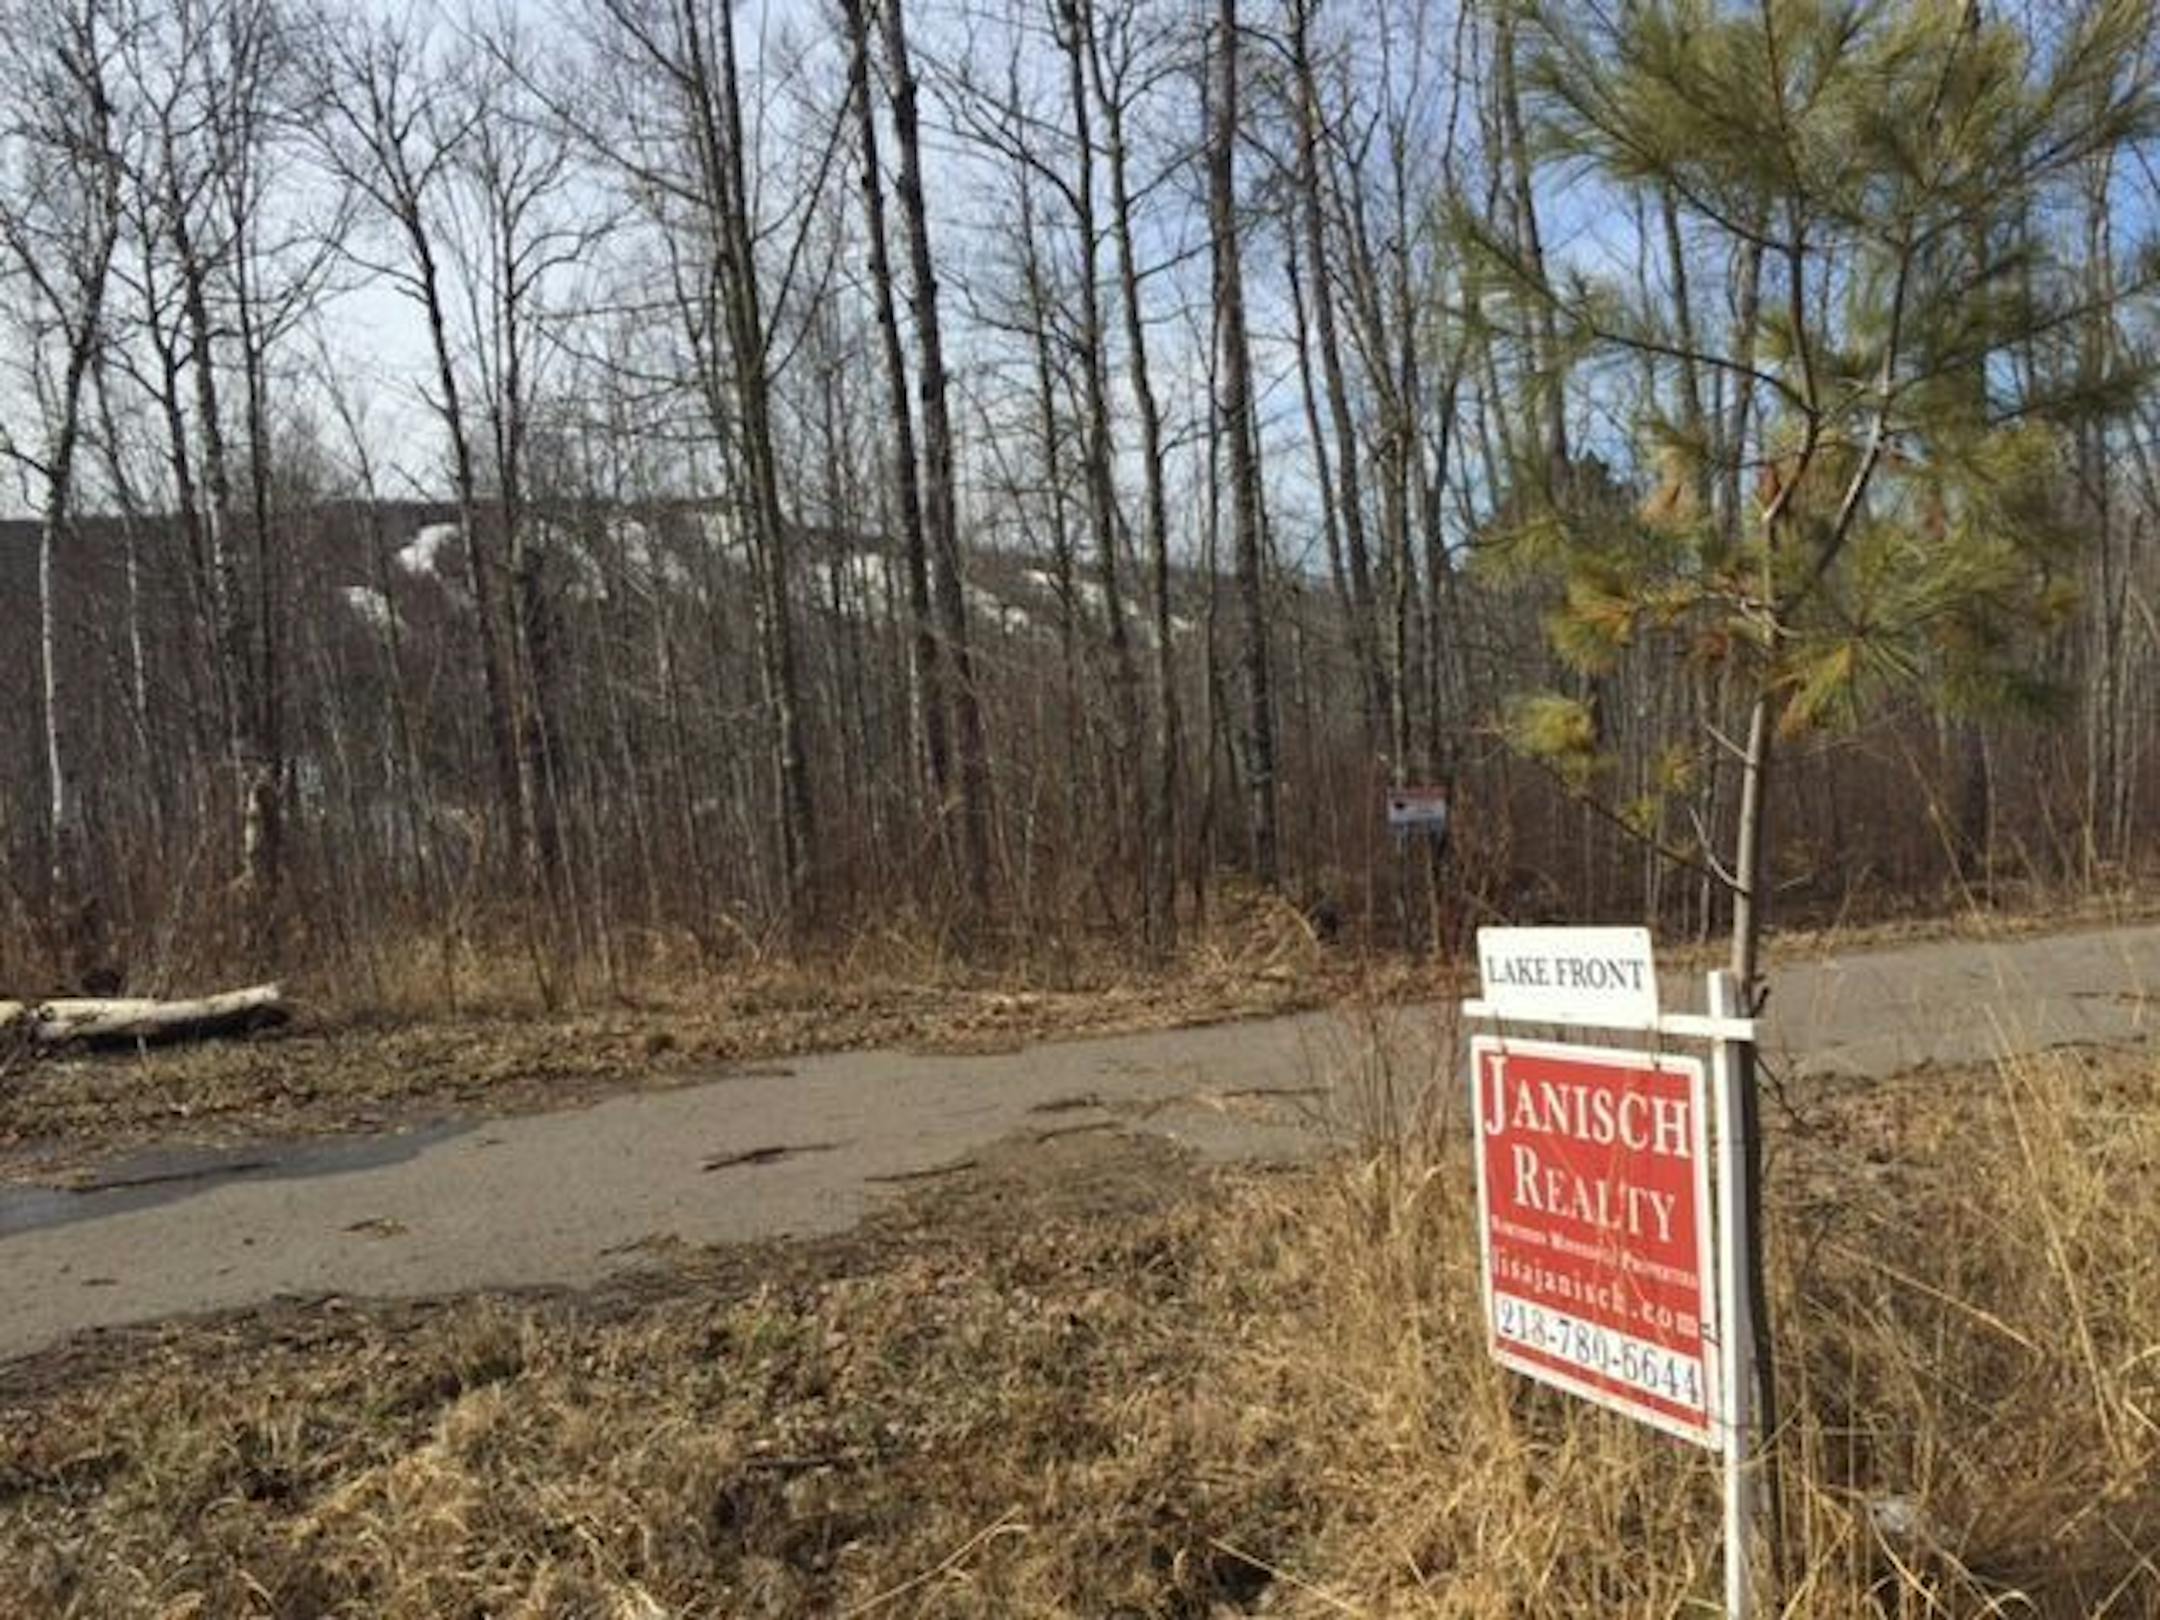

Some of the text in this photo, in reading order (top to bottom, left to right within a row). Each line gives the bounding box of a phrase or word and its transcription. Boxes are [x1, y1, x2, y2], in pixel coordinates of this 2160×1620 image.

[1487, 955, 1645, 990] LAKE FRONT
[1485, 1055, 1690, 1159] JANISCH
[1511, 1144, 1677, 1243] REALTY
[1494, 1245, 1698, 1338] lisajanisch.com
[1501, 1299, 1699, 1404] 218-780-6644
